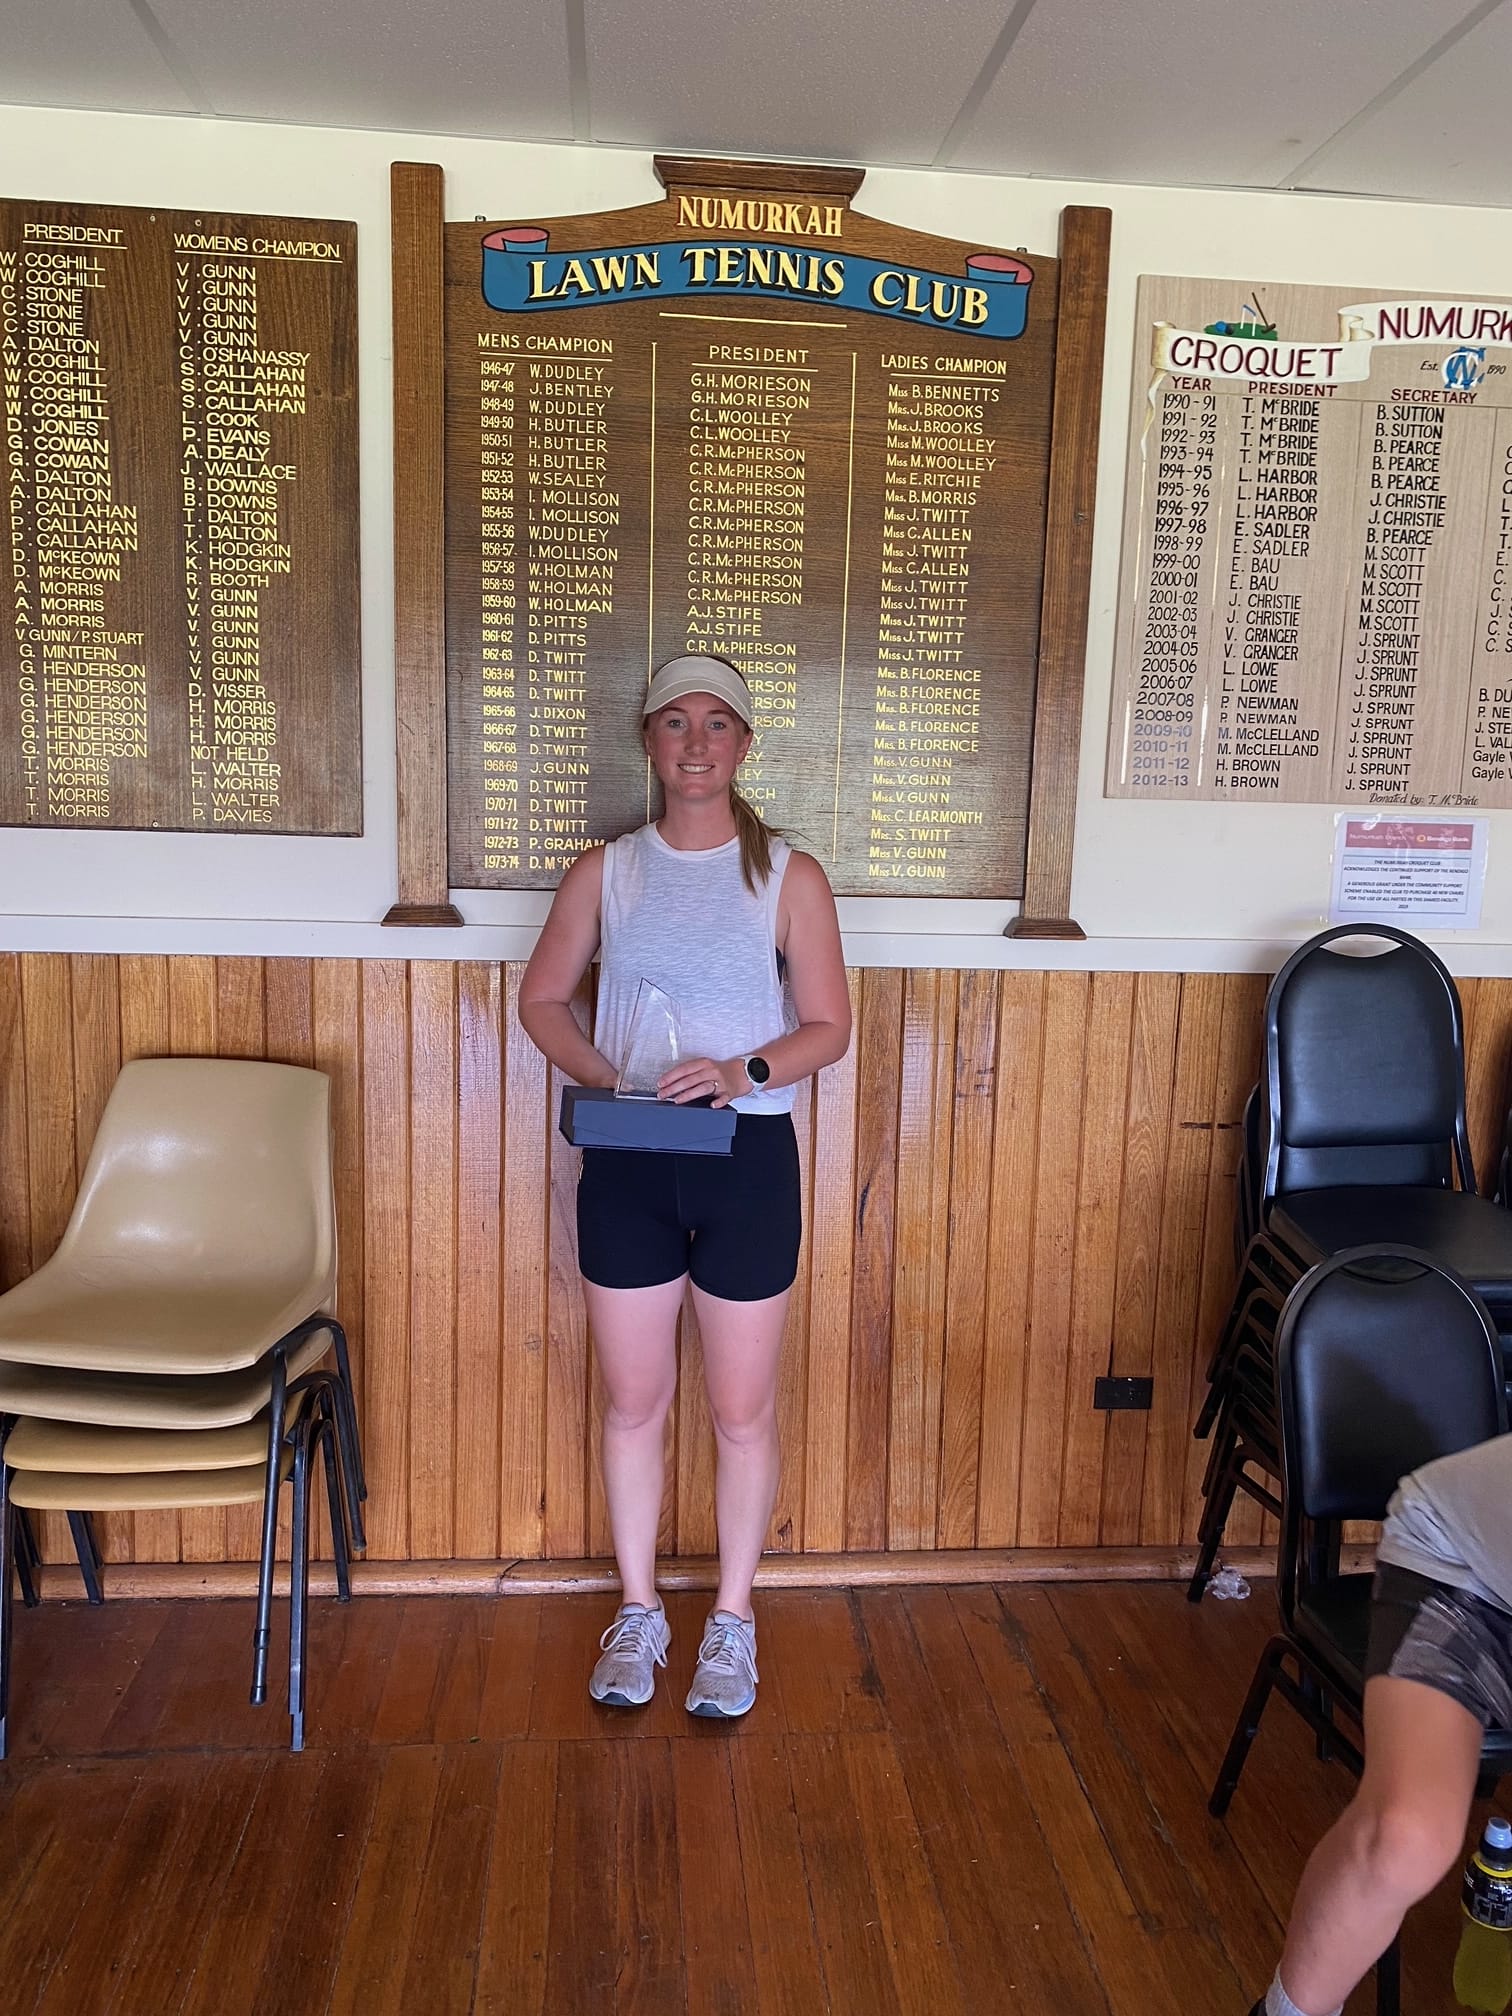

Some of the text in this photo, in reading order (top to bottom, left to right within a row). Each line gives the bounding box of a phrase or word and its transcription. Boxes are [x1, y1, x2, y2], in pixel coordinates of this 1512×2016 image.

[677, 196, 843, 238] NUMURKAH
[24, 224, 123, 244] PRESIDENT
[174, 233, 340, 257] WOMENS CHAMPION
[528, 247, 989, 326] LAWN TENNIS CLUB
[478, 333, 613, 353] MENS CHAMPION
[709, 345, 809, 363] PRESIDENT
[1170, 336, 1343, 378] CROQUET
[481, 361, 515, 375] 1946-47
[881, 354, 1006, 374] LADIES CHAMPION
[1172, 376, 1211, 392] YEAR
[1249, 381, 1337, 398] PRESIDENT
[1391, 389, 1477, 404] SECRETARY
[206, 413, 259, 427] COOK
[1391, 405, 1445, 423] SUTTON
[33, 420, 98, 435] JONES
[481, 415, 514, 429] 1949-50
[208, 429, 271, 445] EVANS
[34, 437, 109, 453] COWAN
[1390, 440, 1441, 456] PEARCE
[208, 446, 269, 462] DEALY
[482, 452, 514, 466] 1951-52
[1160, 446, 1214, 462] 1993-94
[36, 471, 111, 486] DALTON
[1257, 469, 1317, 485] HARBOR
[208, 479, 278, 494] DOWNS
[1157, 482, 1211, 498] 1995-96
[542, 490, 619, 506] MOLLISON
[1385, 493, 1446, 510] CHRISTIE
[922, 508, 969, 523] TWITT
[1154, 517, 1207, 534] 1997-98
[1254, 522, 1310, 539] SADLER
[209, 542, 291, 558] HODGKIN
[1381, 546, 1426, 563] SCOTT
[1251, 558, 1280, 574] BAU
[211, 574, 269, 588] BOOTH
[1151, 571, 1198, 588] 2000-01
[40, 582, 103, 596] MORRIS
[211, 589, 257, 602] GUNN
[1248, 594, 1301, 610] CHRISTIE
[483, 612, 513, 625] 1960-61
[544, 615, 587, 629] PITTS
[1145, 625, 1197, 641] 2003-04
[1245, 628, 1297, 644] GRANGER
[43, 645, 117, 661] MINTERN
[483, 648, 512, 661] 1962-63
[545, 652, 586, 665] TWITT
[916, 650, 962, 662] TWITT
[43, 661, 145, 678] HENDERSON
[1141, 658, 1197, 674] 2005-06
[1242, 662, 1278, 677] LOWE
[213, 685, 265, 699] VISSER
[215, 701, 276, 715] MORRIS
[1237, 696, 1298, 711] NEWMAN
[1368, 702, 1415, 716] SPRUNT
[1134, 708, 1193, 723] 2008-09
[1236, 728, 1319, 742] McCLELLAND
[1363, 732, 1413, 746] SPRUNT
[47, 743, 147, 758] HENDERSON
[191, 747, 269, 761] NOT HELD
[1133, 740, 1188, 755] 2010-11
[47, 757, 110, 771] MORRIS
[1473, 750, 1505, 765] Gayle
[212, 763, 281, 778] WALTER
[484, 759, 517, 772] 1968-69
[1132, 773, 1189, 787] 2012-13
[1231, 776, 1279, 789] BROWN
[1360, 779, 1409, 793] SPRUNT
[49, 804, 110, 817] MORRIS
[485, 797, 517, 811] 1970-71
[214, 809, 272, 823] DAVIES
[909, 810, 982, 824] LEARMONTH
[485, 836, 518, 849] 1972-73
[910, 829, 951, 841] TWITT
[907, 866, 945, 878] GUNN
